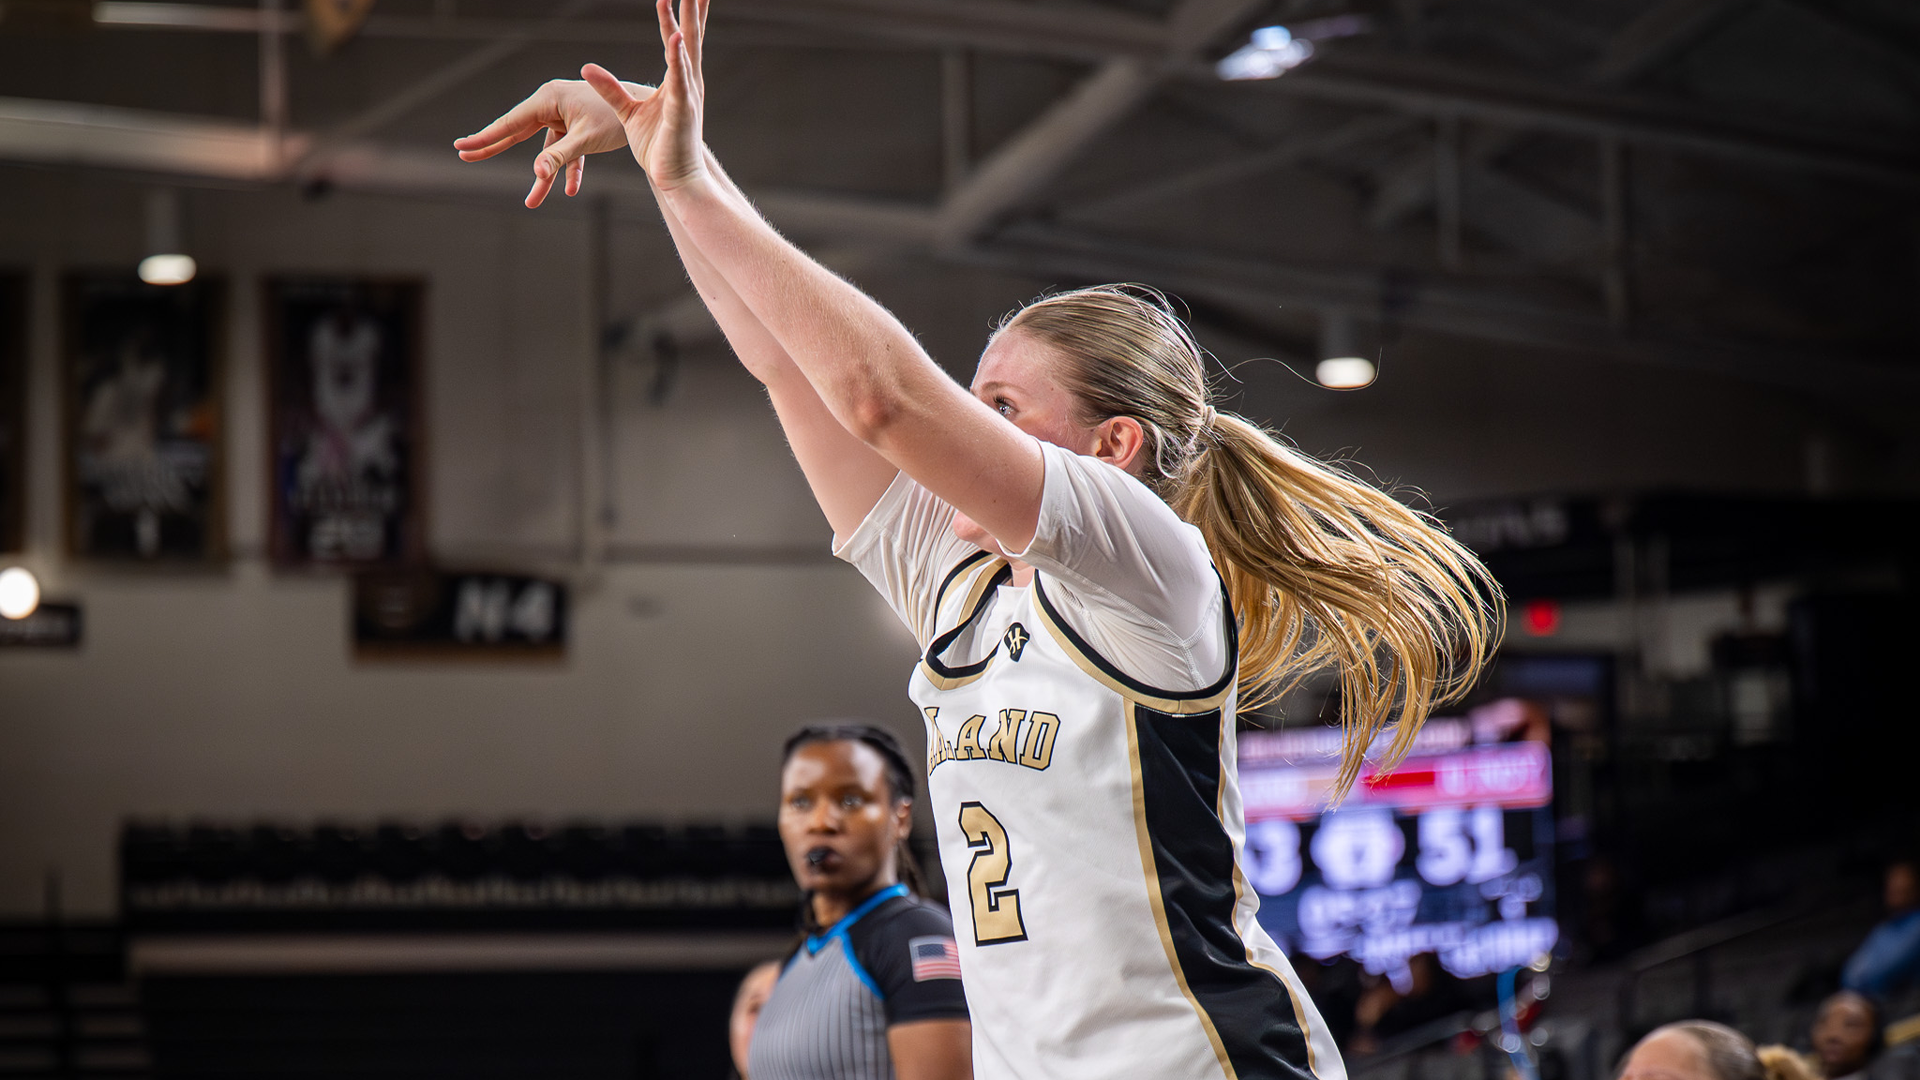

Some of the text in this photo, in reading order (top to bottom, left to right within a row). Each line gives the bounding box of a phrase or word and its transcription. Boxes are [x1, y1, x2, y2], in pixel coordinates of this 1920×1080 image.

[924, 706, 1061, 776] LAND
[958, 801, 1028, 947] 2
[1416, 806, 1518, 887] 51
